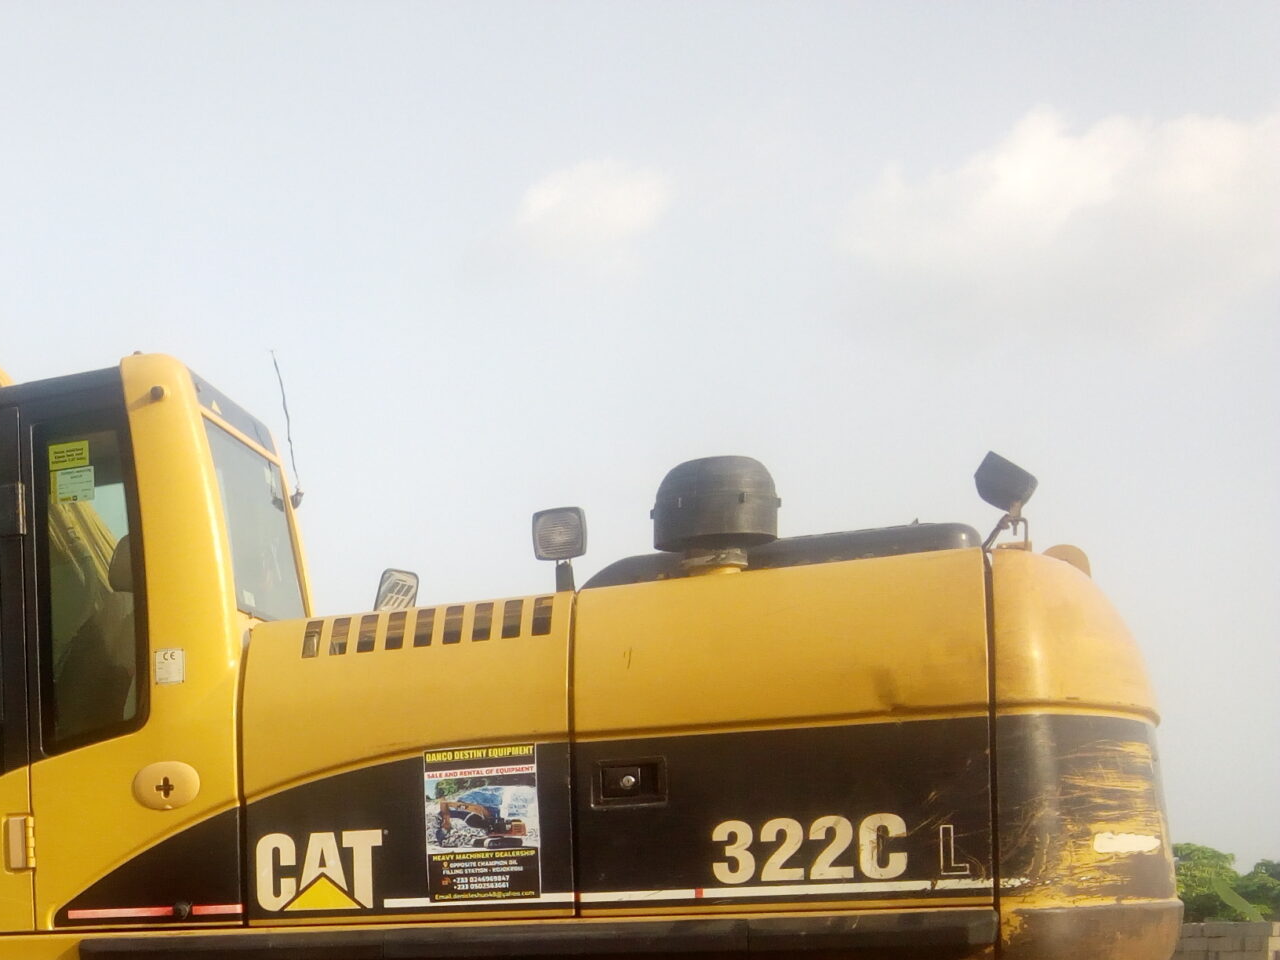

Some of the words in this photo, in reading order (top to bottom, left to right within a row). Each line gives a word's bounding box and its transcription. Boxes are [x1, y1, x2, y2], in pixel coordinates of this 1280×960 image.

[426, 751, 453, 763] DANCO
[454, 749, 487, 760] DESTINY
[488, 745, 534, 757] EQUIPMENT
[495, 765, 534, 774] EQUIPMENT
[712, 812, 908, 884] 322C
[939, 824, 970, 876] L
[455, 851, 494, 860] MACHINERY
[495, 849, 536, 858] DEALERSHIP
[256, 829, 383, 912] CAT
[449, 861, 477, 869] OPPOSITE
[453, 876, 468, 884] +233
